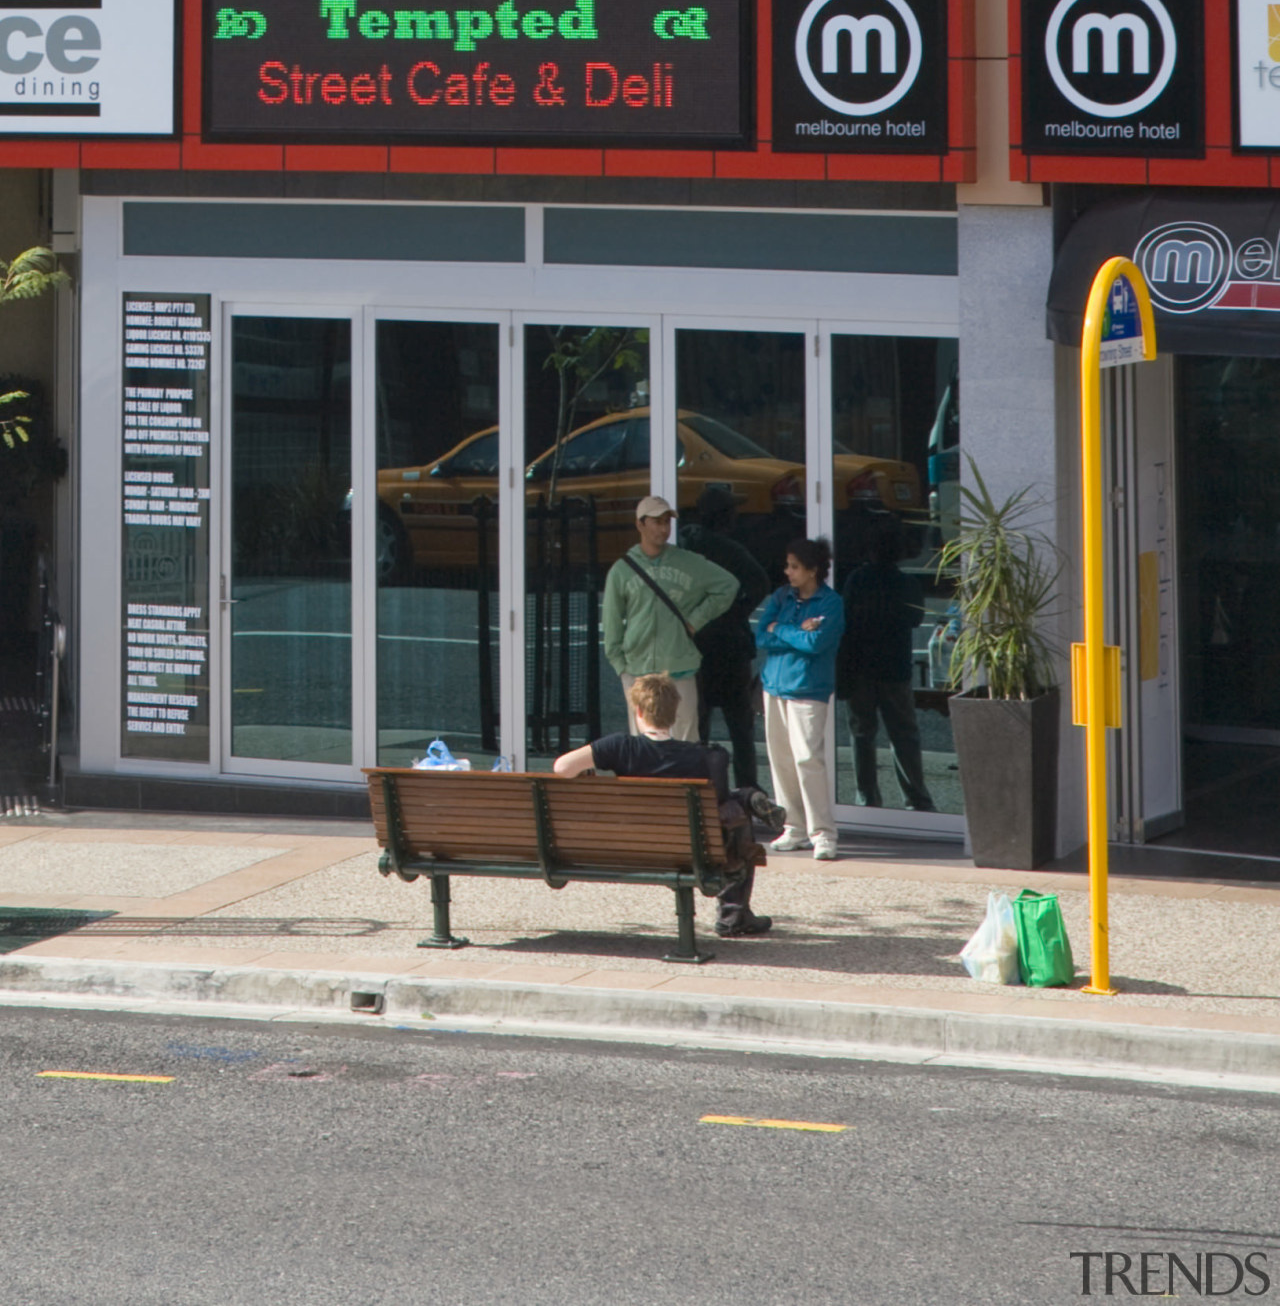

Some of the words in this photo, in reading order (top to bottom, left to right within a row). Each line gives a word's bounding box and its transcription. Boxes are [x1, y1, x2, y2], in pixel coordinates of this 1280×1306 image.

[15, 77, 100, 100] dining
[258, 61, 393, 105] Street
[406, 61, 516, 106] Cafe
[532, 62, 565, 106] &
[585, 62, 674, 107] Deli
[795, 120, 881, 136] melbourne
[886, 120, 925, 137] hotel
[1045, 121, 1134, 138] melbourne
[1139, 122, 1180, 140] hotel
